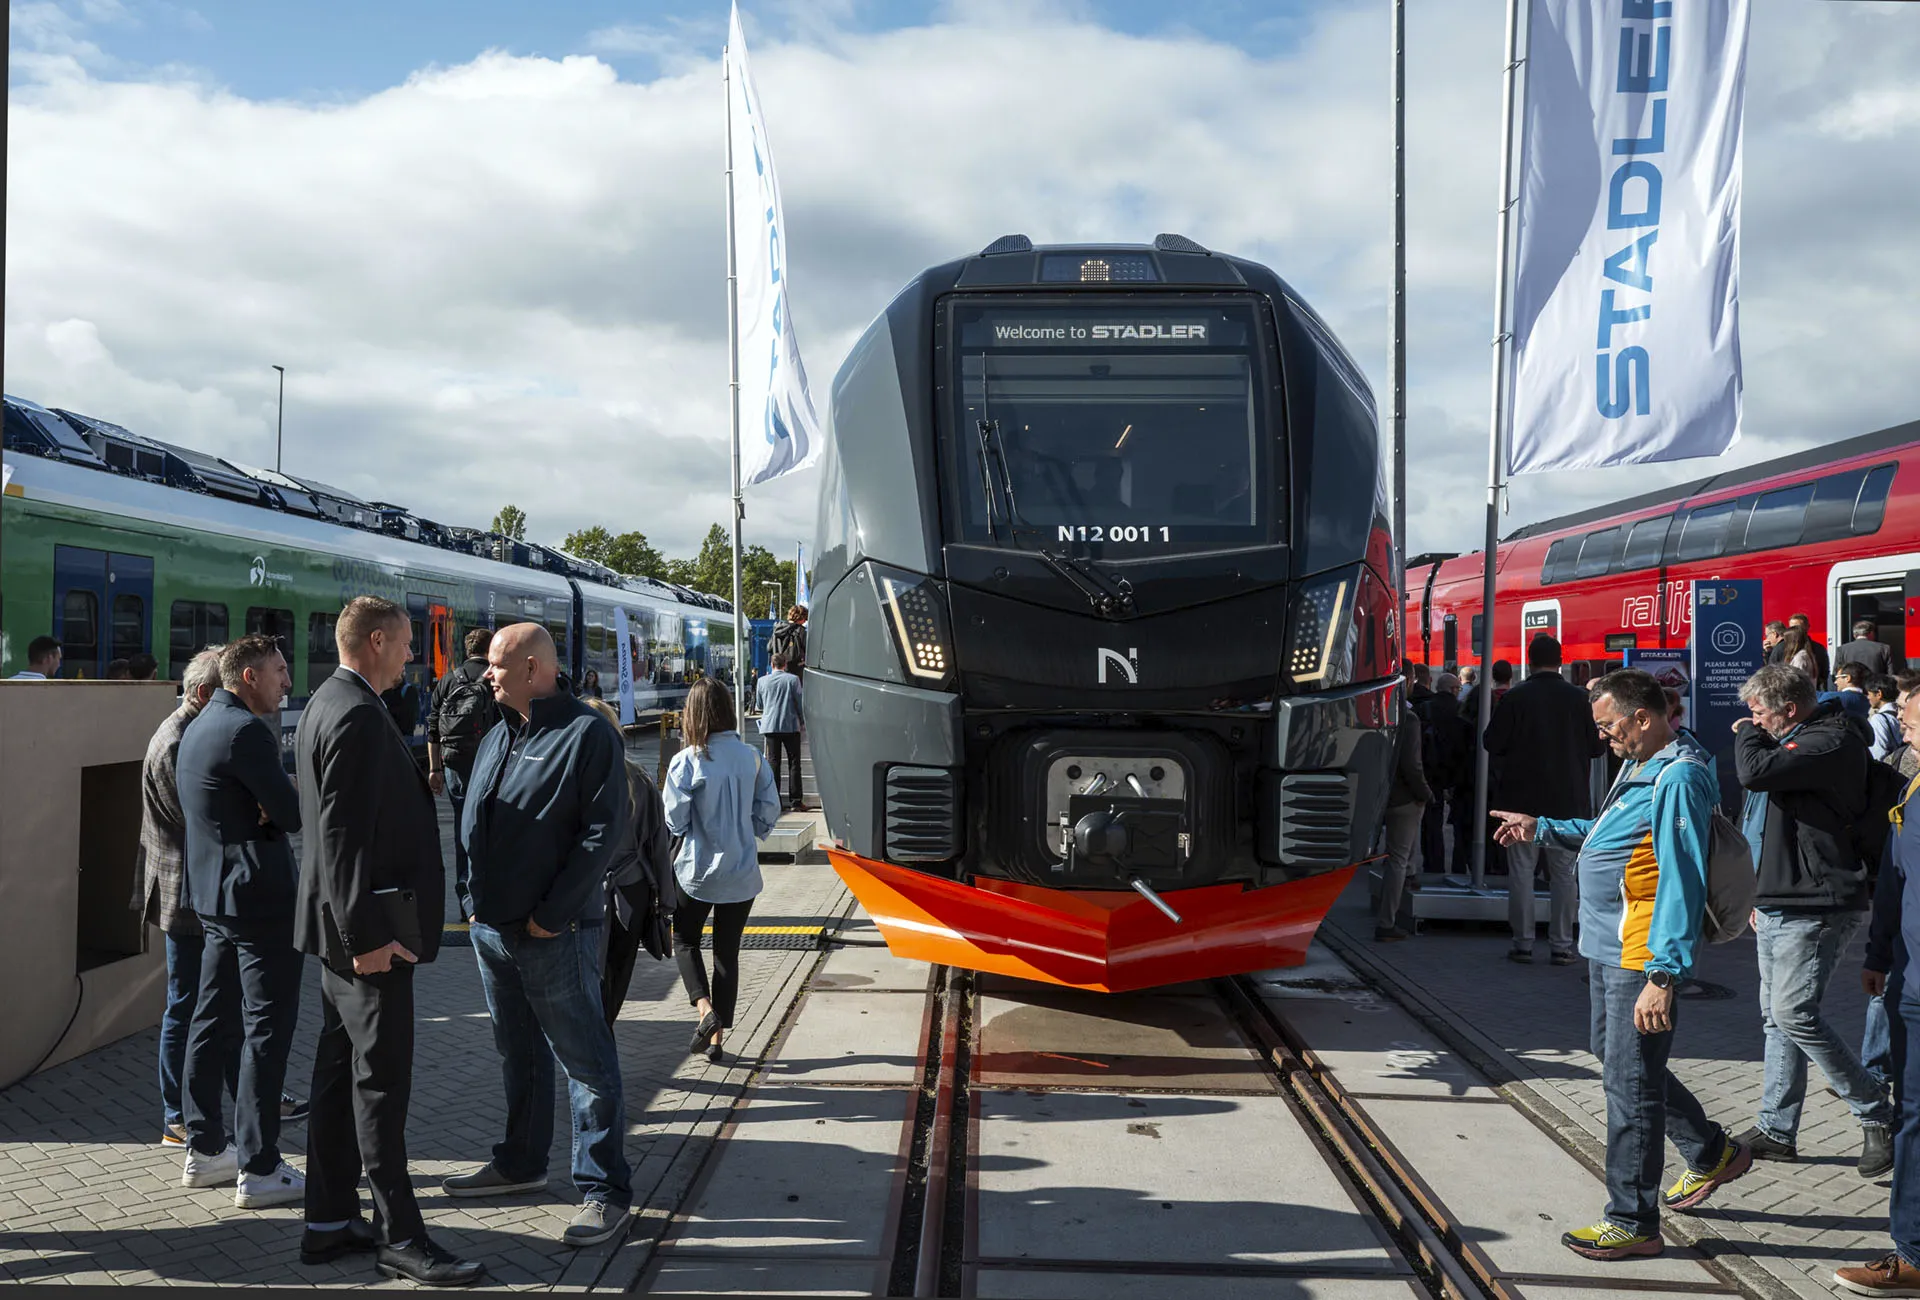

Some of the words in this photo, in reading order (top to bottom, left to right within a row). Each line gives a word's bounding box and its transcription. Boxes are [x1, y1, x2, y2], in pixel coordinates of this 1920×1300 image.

[1597, 0, 1673, 420] STADLE
[996, 325, 1065, 339] Welcome
[1070, 326, 1086, 339] to
[1092, 325, 1205, 339] STADLER
[1058, 525, 1104, 542] N12
[1109, 526, 1150, 542] 001
[1159, 526, 1170, 542] 1
[1621, 576, 1720, 635] railj
